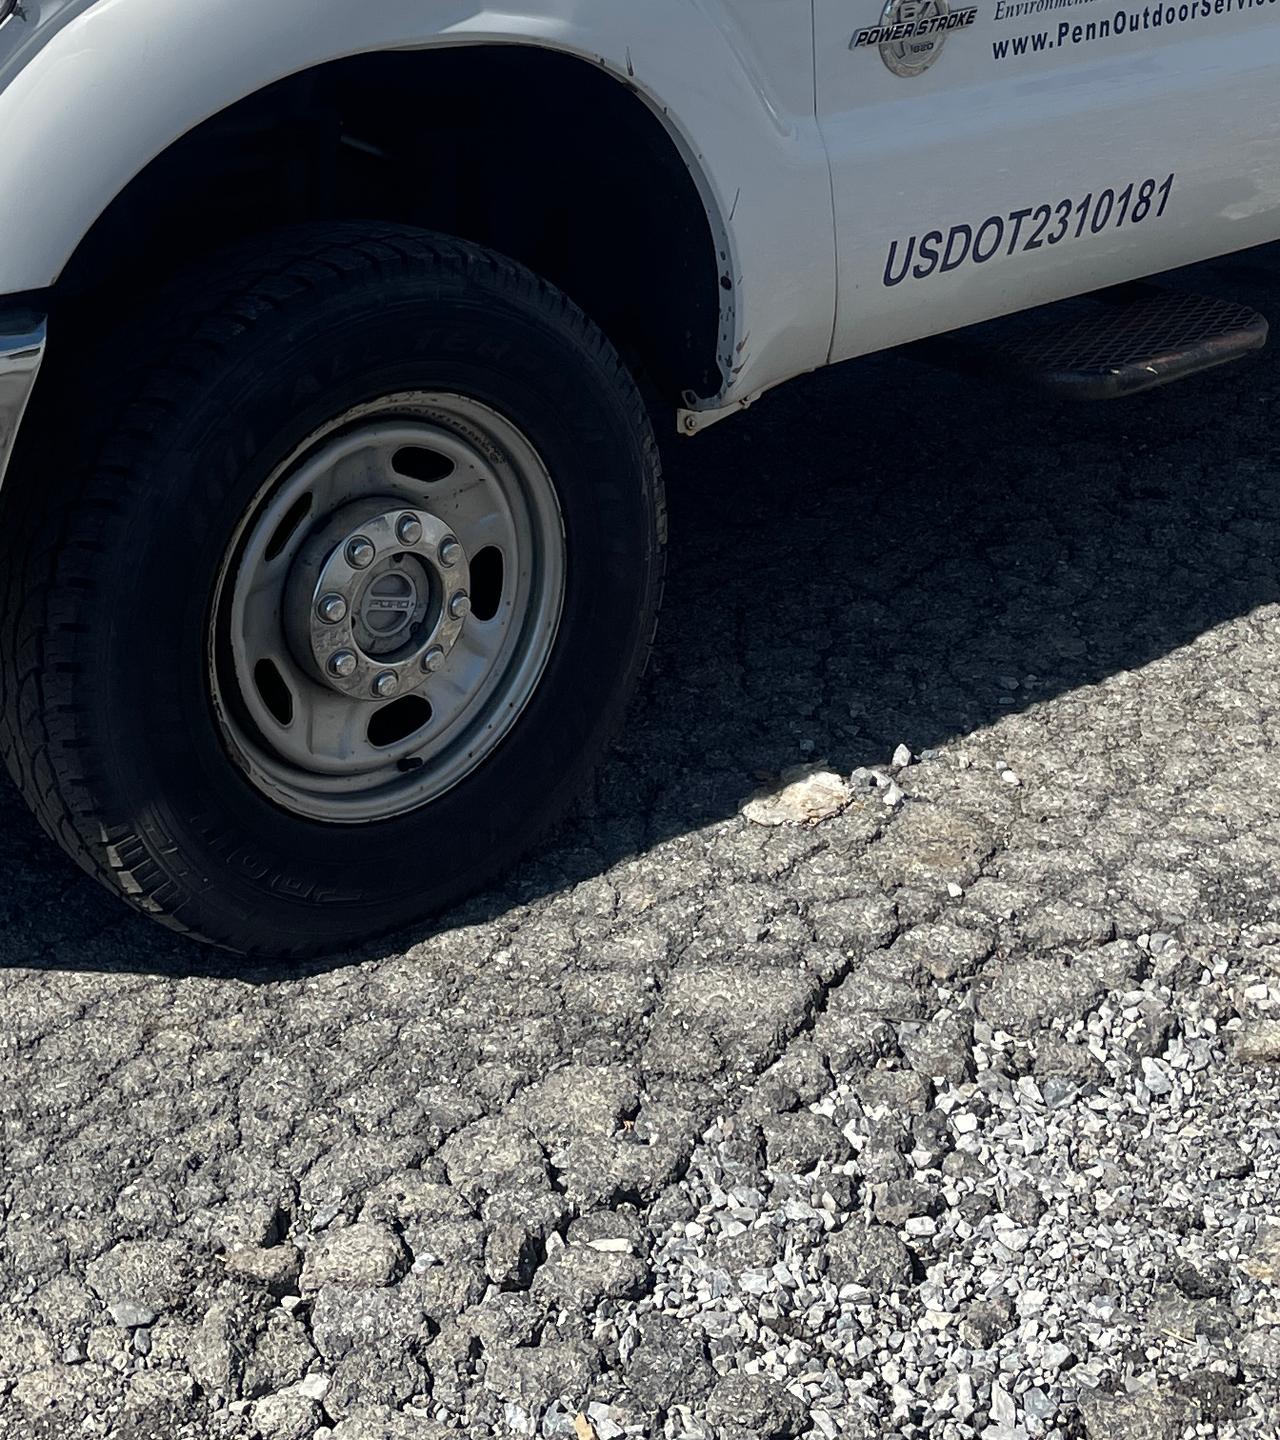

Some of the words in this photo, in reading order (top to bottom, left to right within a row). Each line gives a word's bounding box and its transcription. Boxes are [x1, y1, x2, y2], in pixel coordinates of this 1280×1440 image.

[854, 23, 915, 47] POWER
[916, 8, 978, 37] STROKE
[883, 173, 1175, 287] USDOT2310181
